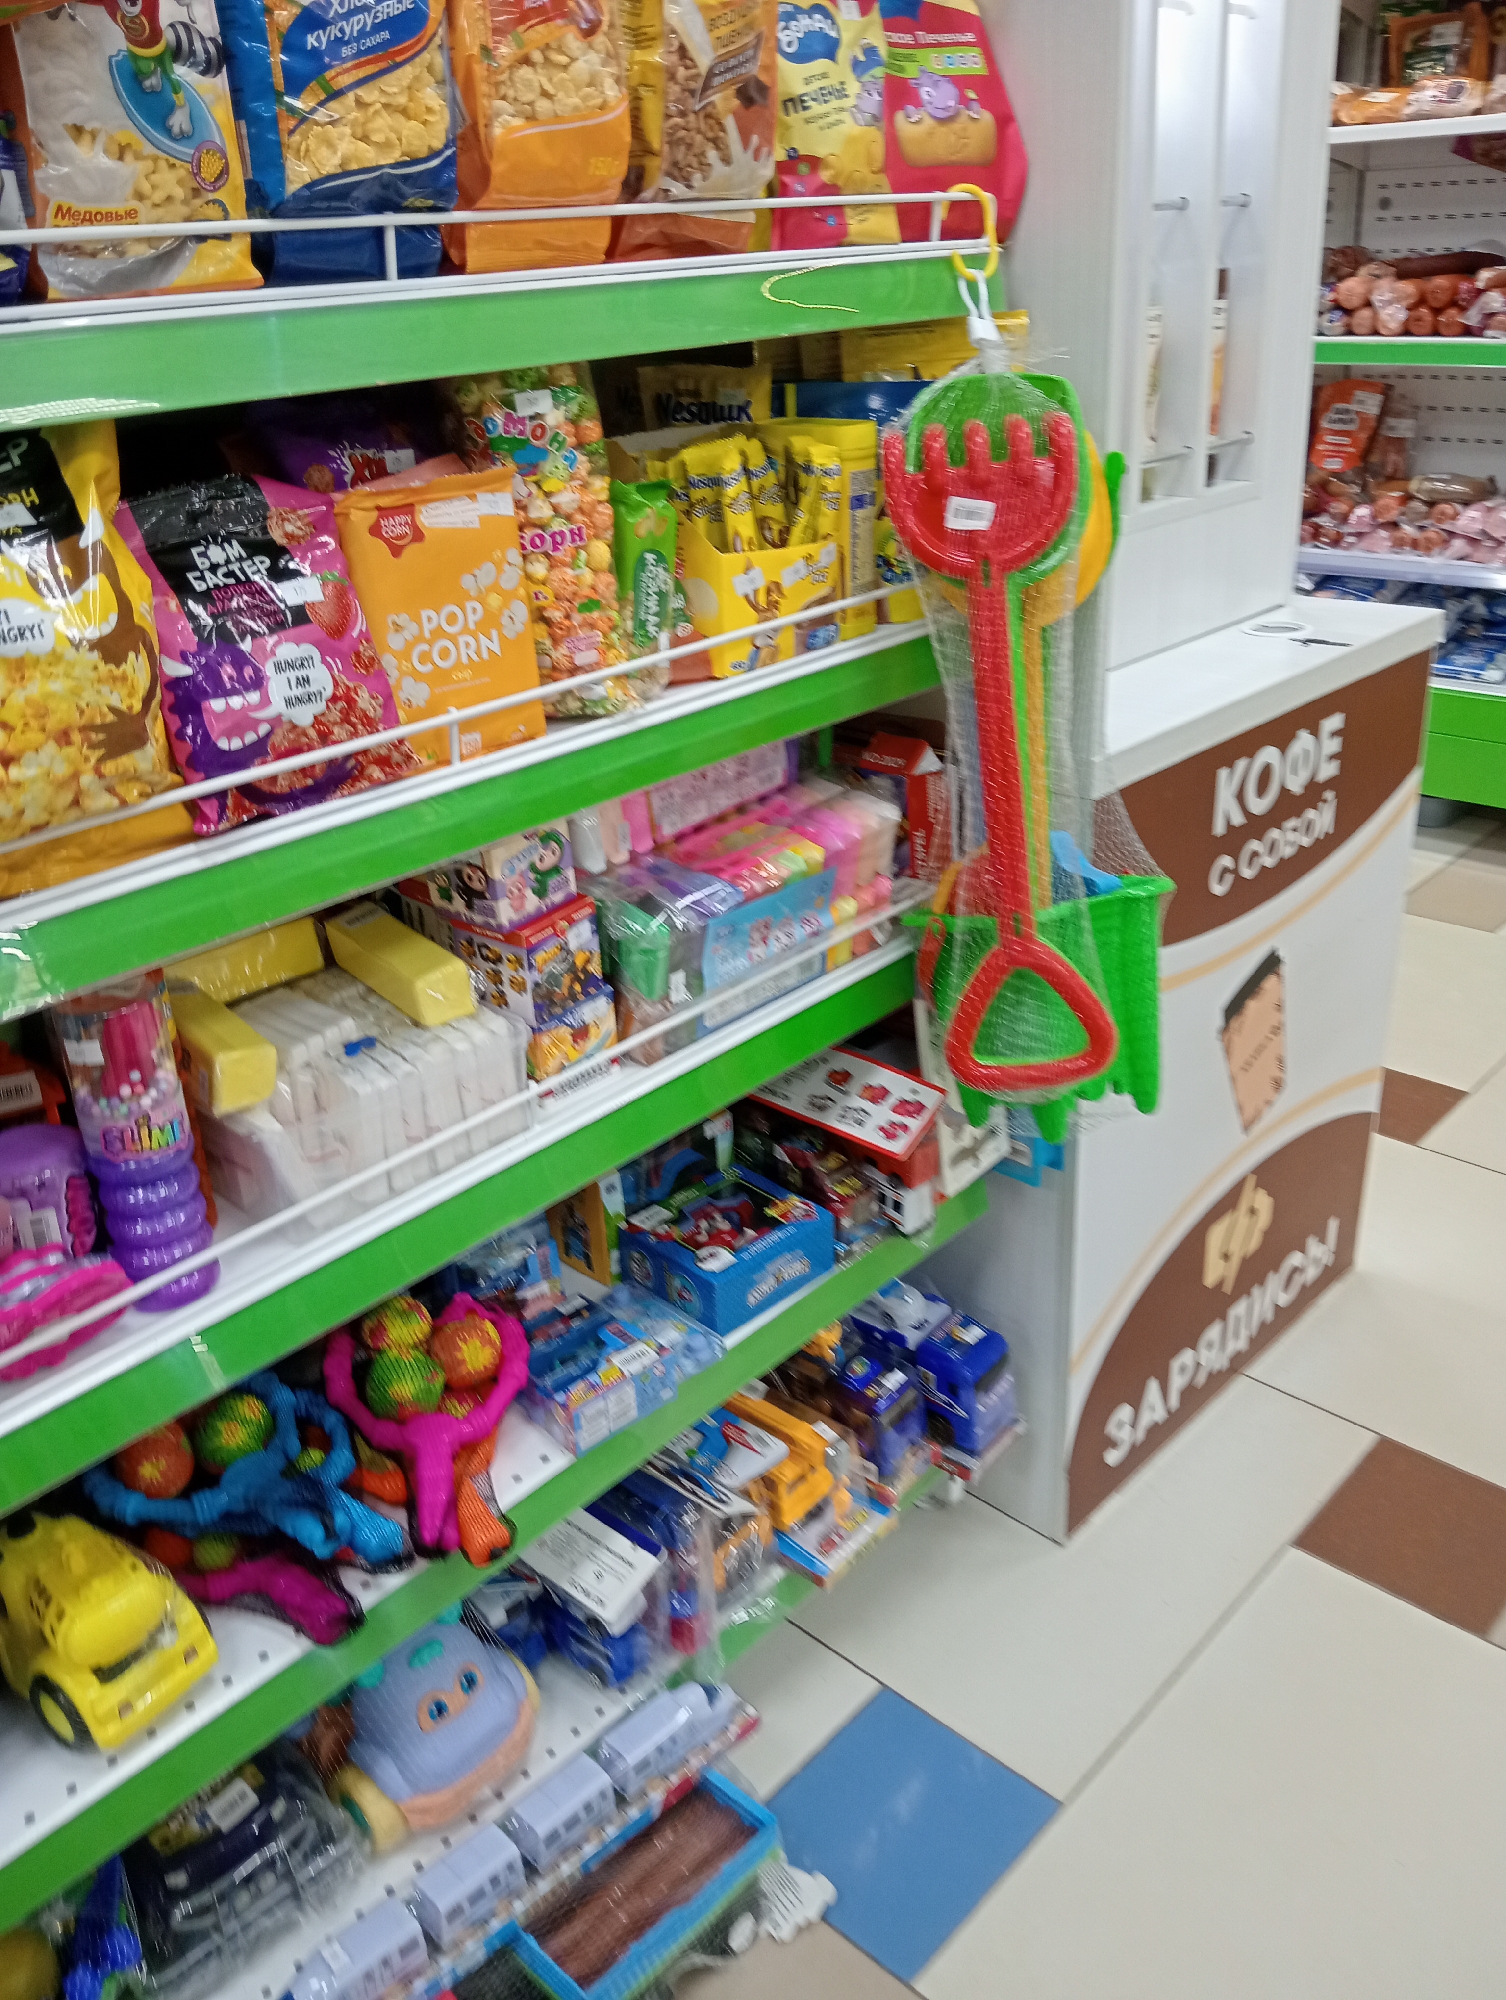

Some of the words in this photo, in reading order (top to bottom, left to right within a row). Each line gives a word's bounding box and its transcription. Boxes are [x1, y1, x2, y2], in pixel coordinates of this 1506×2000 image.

[341, 42, 357, 58] БЕЗ
[360, 30, 391, 50] САХАРА
[53, 204, 139, 225] Медовые
[379, 514, 413, 529] HAPPY
[381, 525, 411, 540] CORN
[186, 554, 271, 593] БАСТЕР
[420, 600, 485, 639] POP
[411, 628, 502, 674] CORN
[1211, 711, 1347, 838] КОФЕ
[1103, 1215, 1340, 1468] ЗАРЯДИСЬ!
